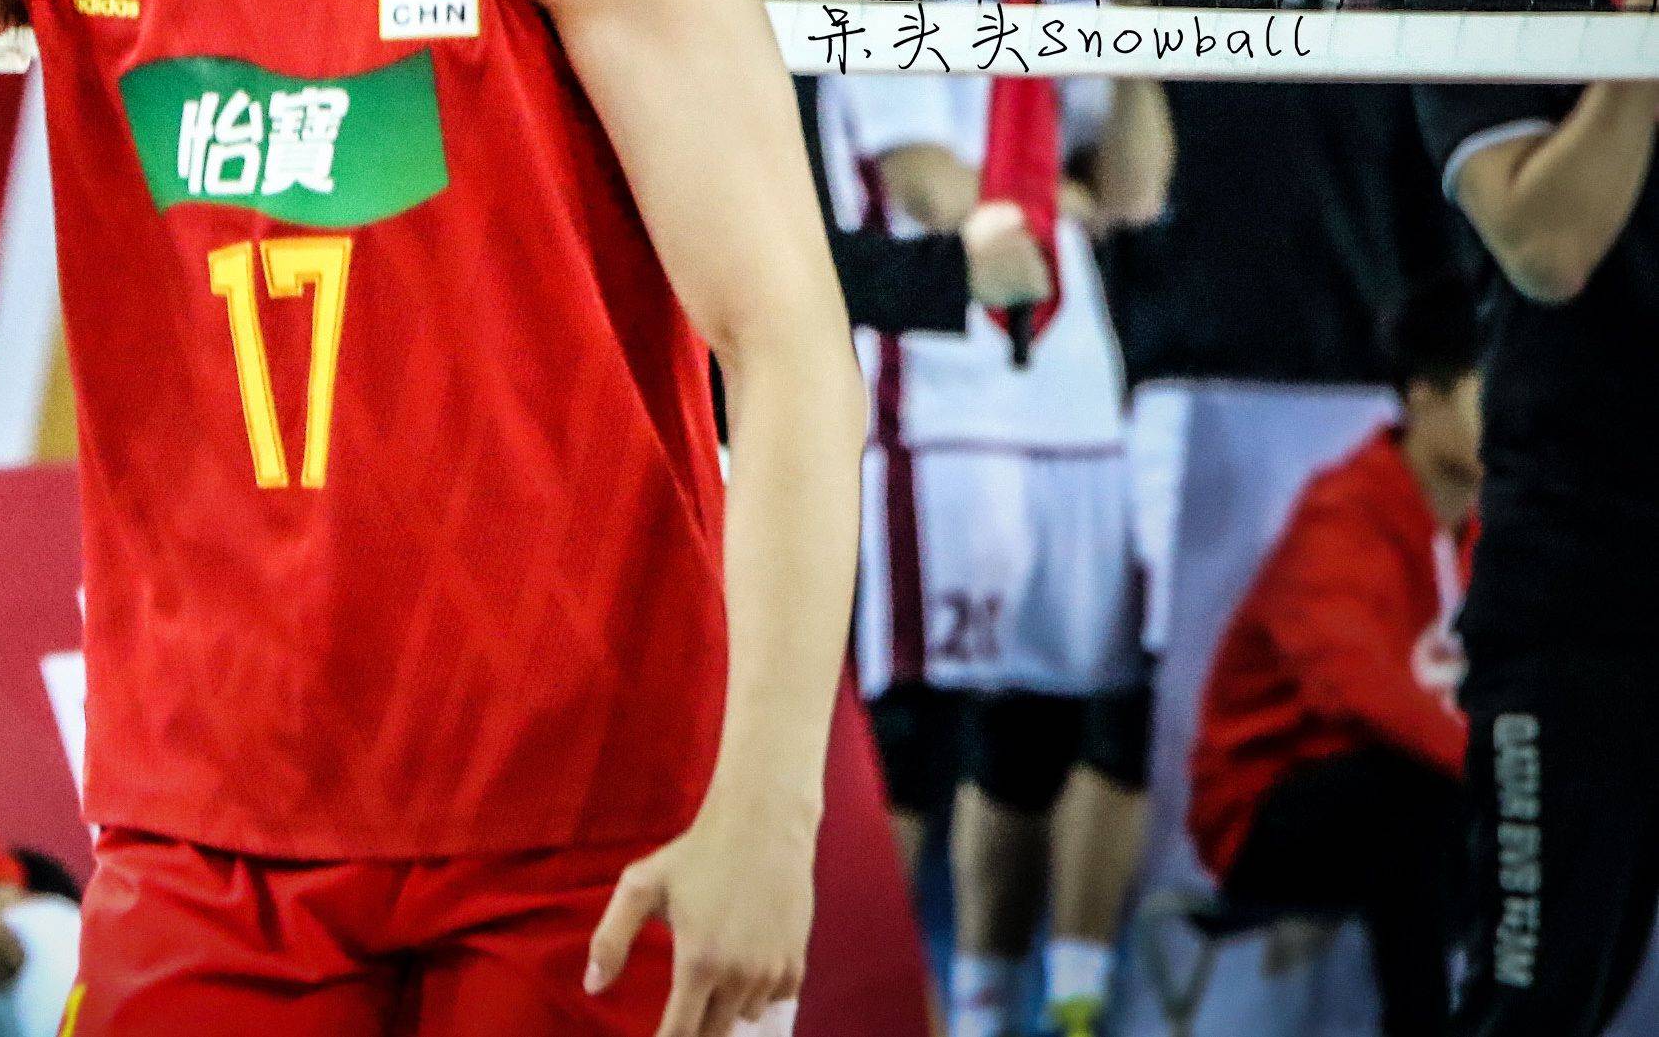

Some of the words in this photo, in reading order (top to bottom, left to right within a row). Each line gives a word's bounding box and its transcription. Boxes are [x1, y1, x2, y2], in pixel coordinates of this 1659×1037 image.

[392, 3, 466, 26] CHN
[178, 86, 349, 195] 怡寶
[207, 236, 353, 489] 17
